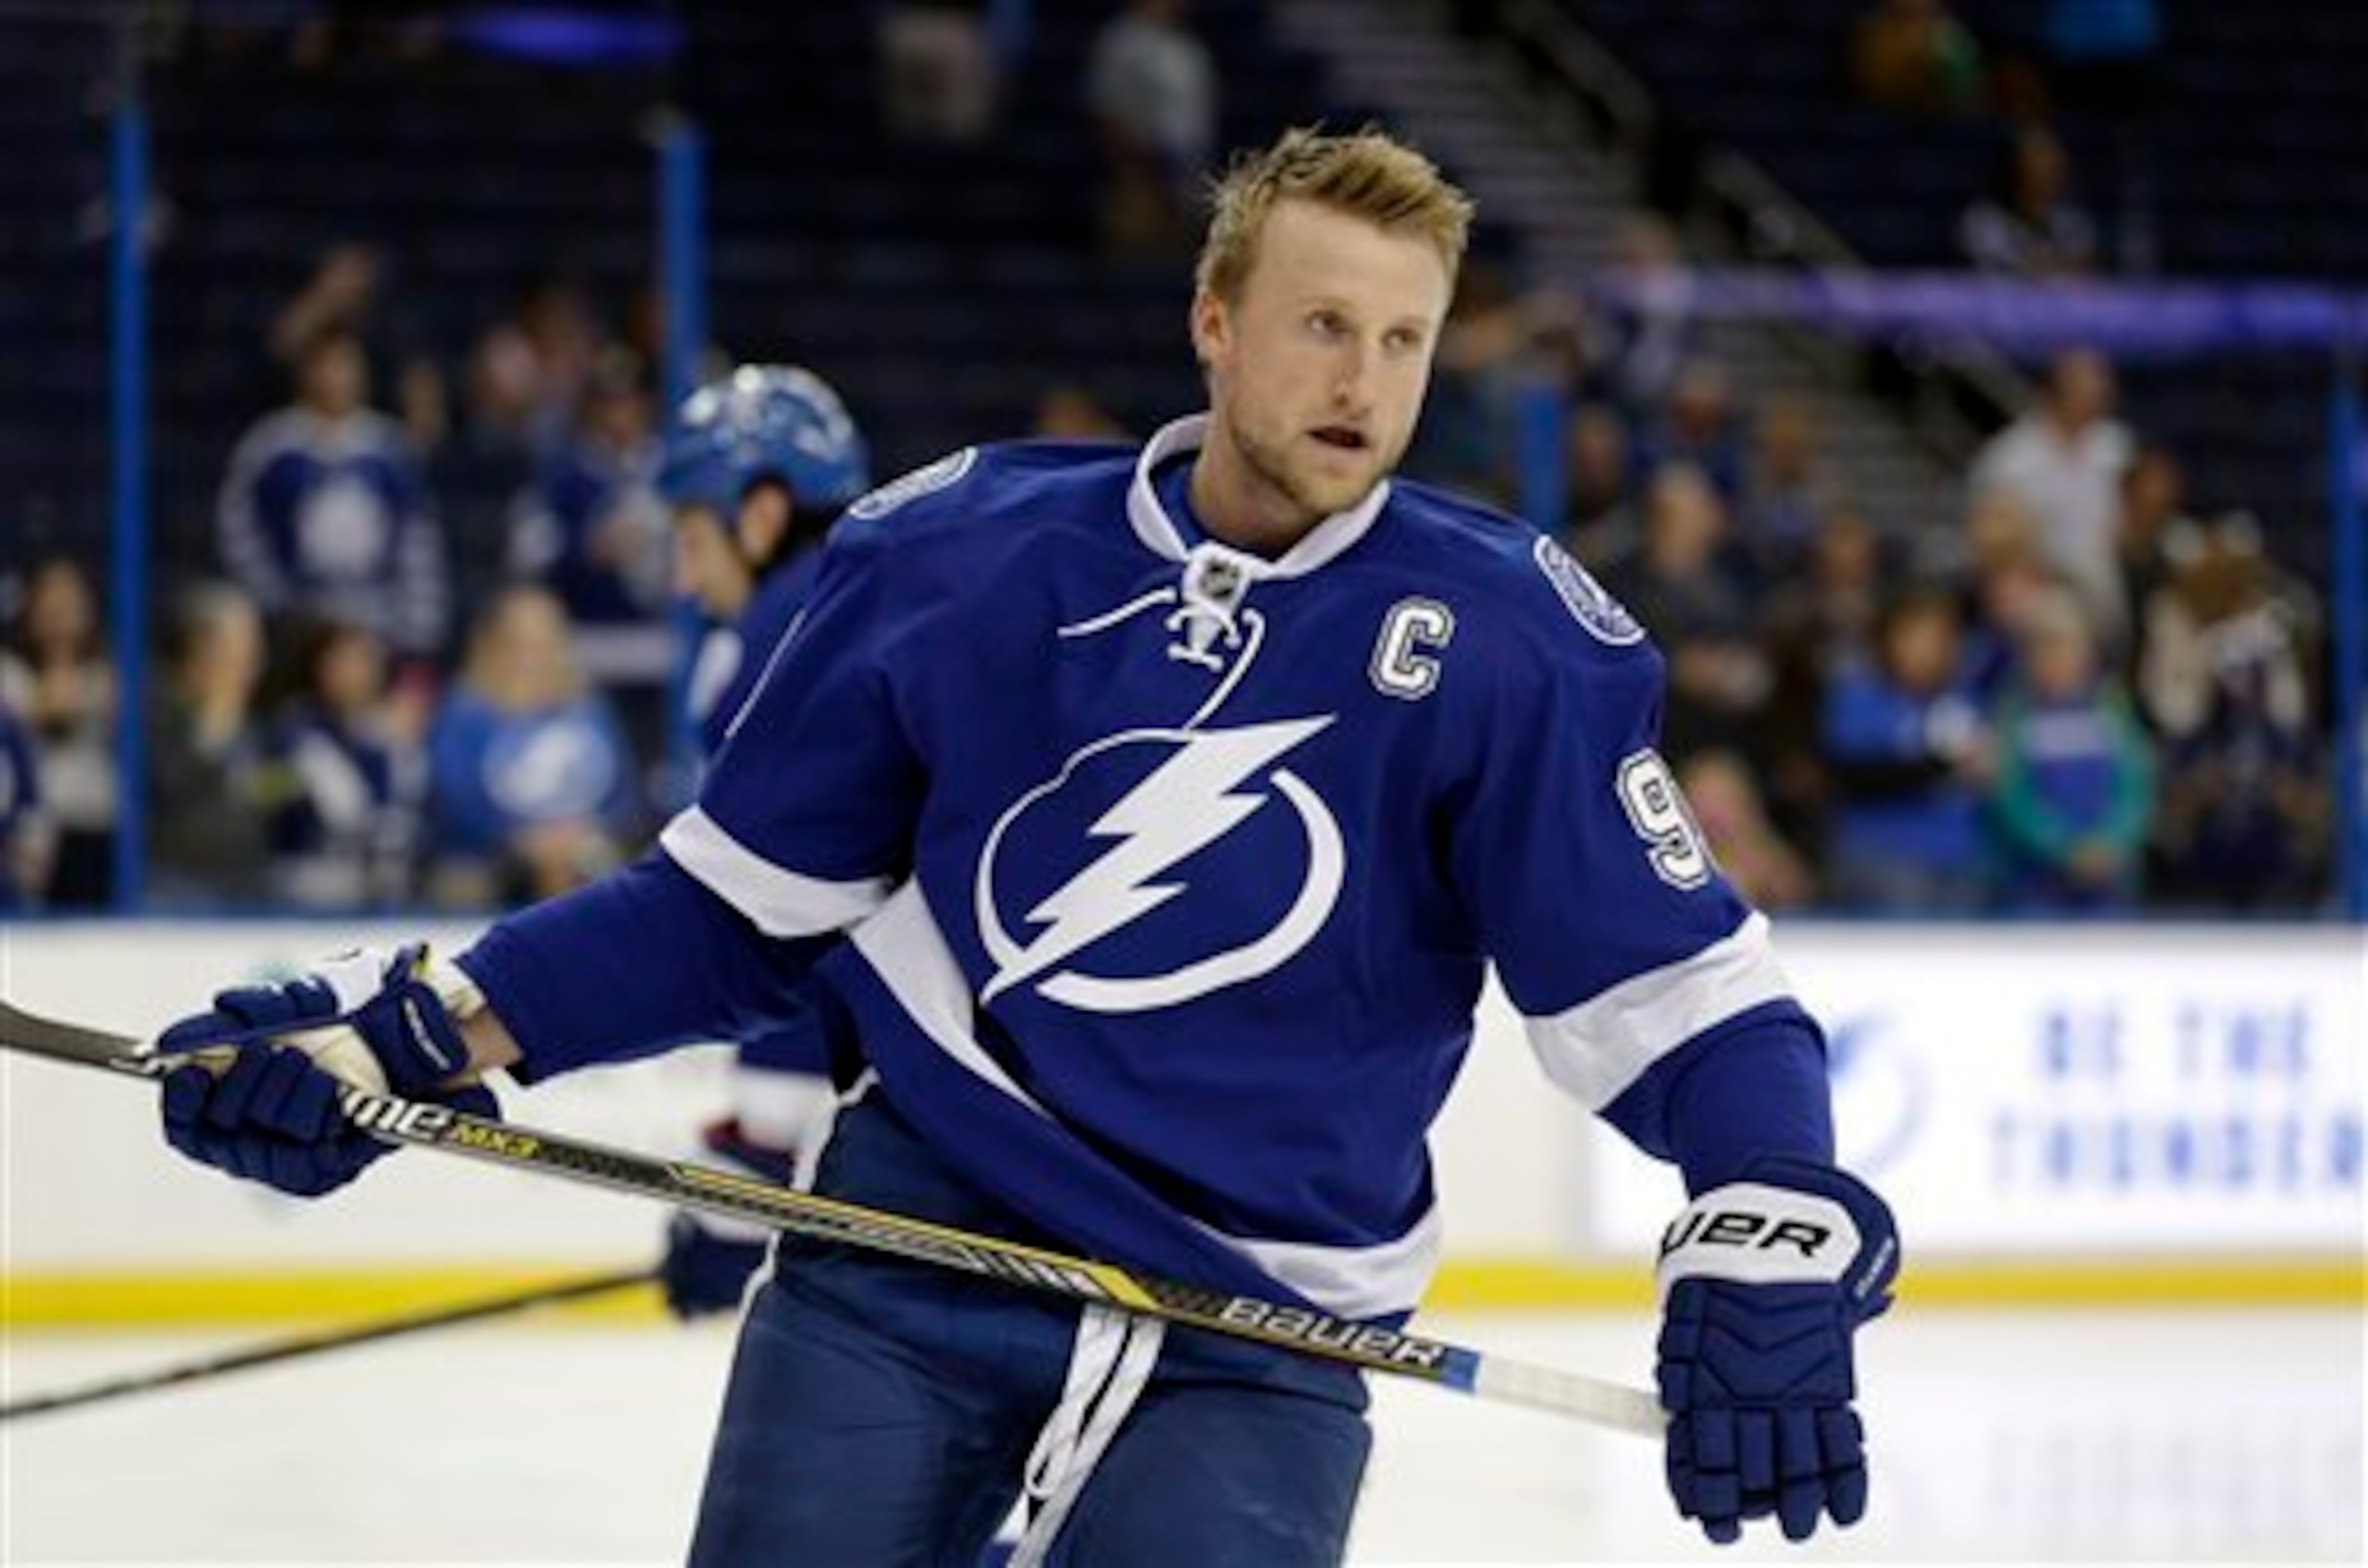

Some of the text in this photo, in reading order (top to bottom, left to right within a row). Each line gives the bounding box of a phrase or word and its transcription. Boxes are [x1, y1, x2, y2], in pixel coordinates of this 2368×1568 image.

[1368, 597, 1454, 699] C
[1616, 747, 1712, 890] 9
[1218, 1296, 1446, 1368] BAUER
